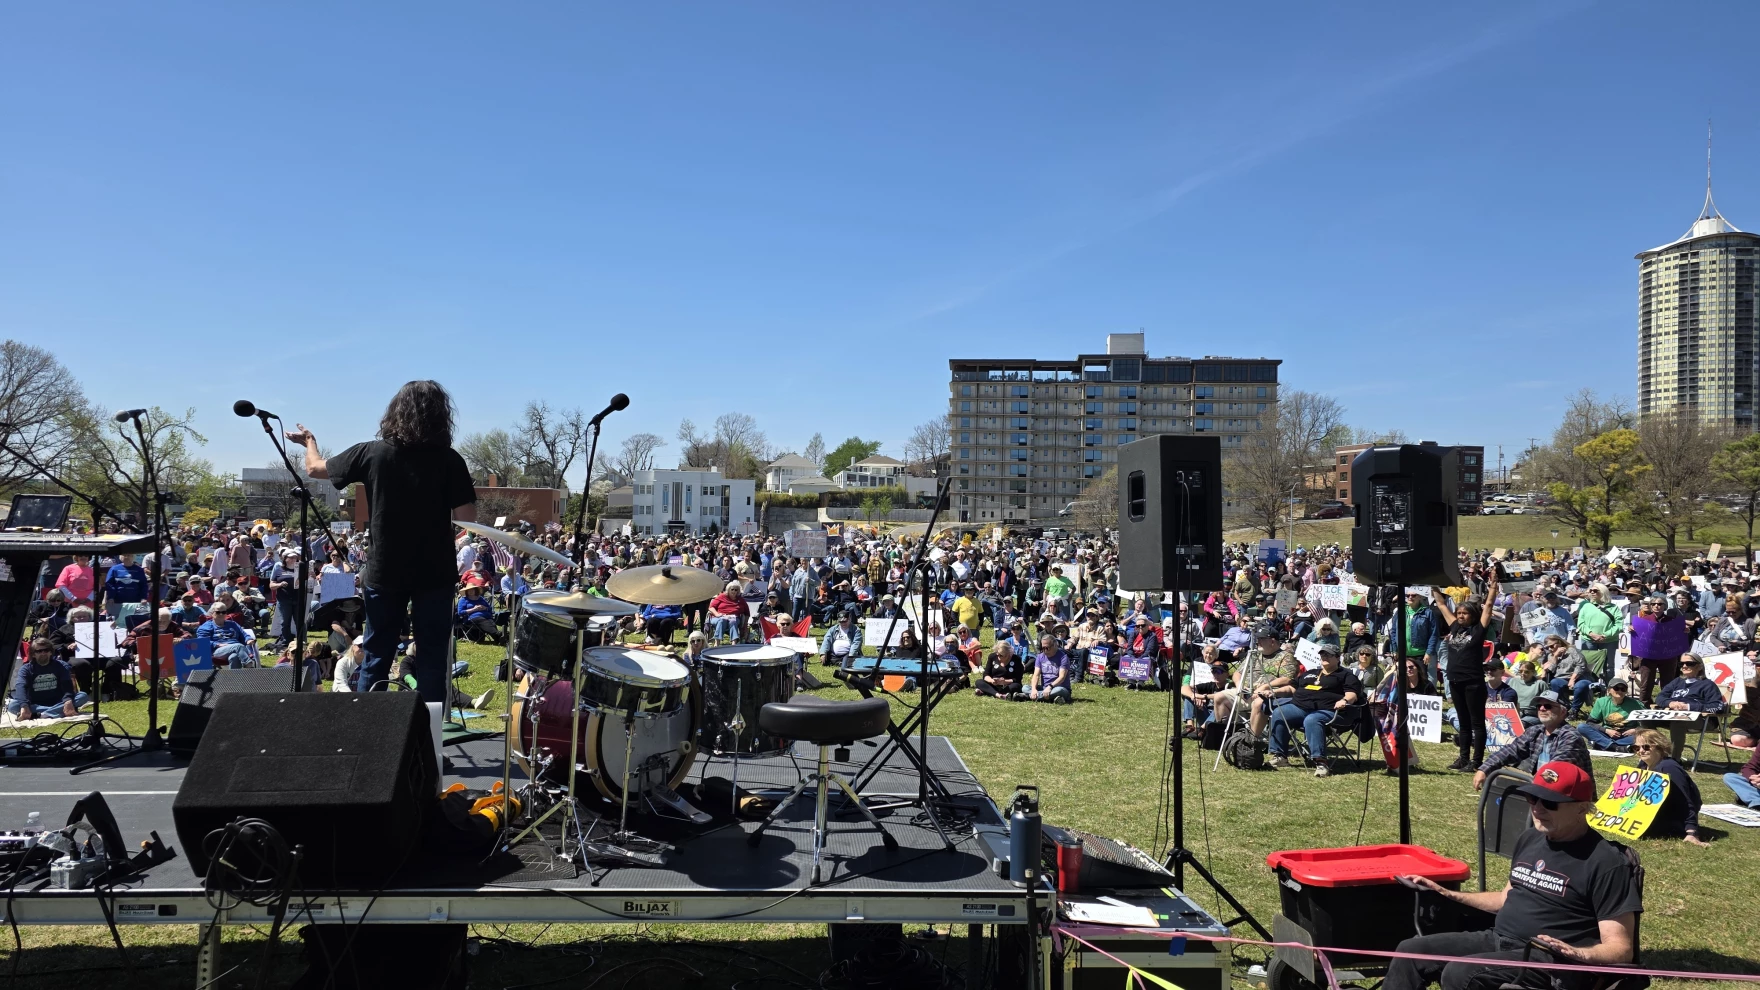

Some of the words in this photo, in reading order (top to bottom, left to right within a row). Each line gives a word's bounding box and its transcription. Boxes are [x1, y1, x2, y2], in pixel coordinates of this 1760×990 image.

[1324, 600, 1345, 608] KINGS
[1121, 668, 1147, 676] AMERICA
[1619, 770, 1669, 794] POWER
[1607, 784, 1659, 806] BELONGS
[1590, 811, 1643, 836] PEOPLE
[1531, 871, 1564, 885] AMERICA
[1538, 880, 1563, 892] AGAIN
